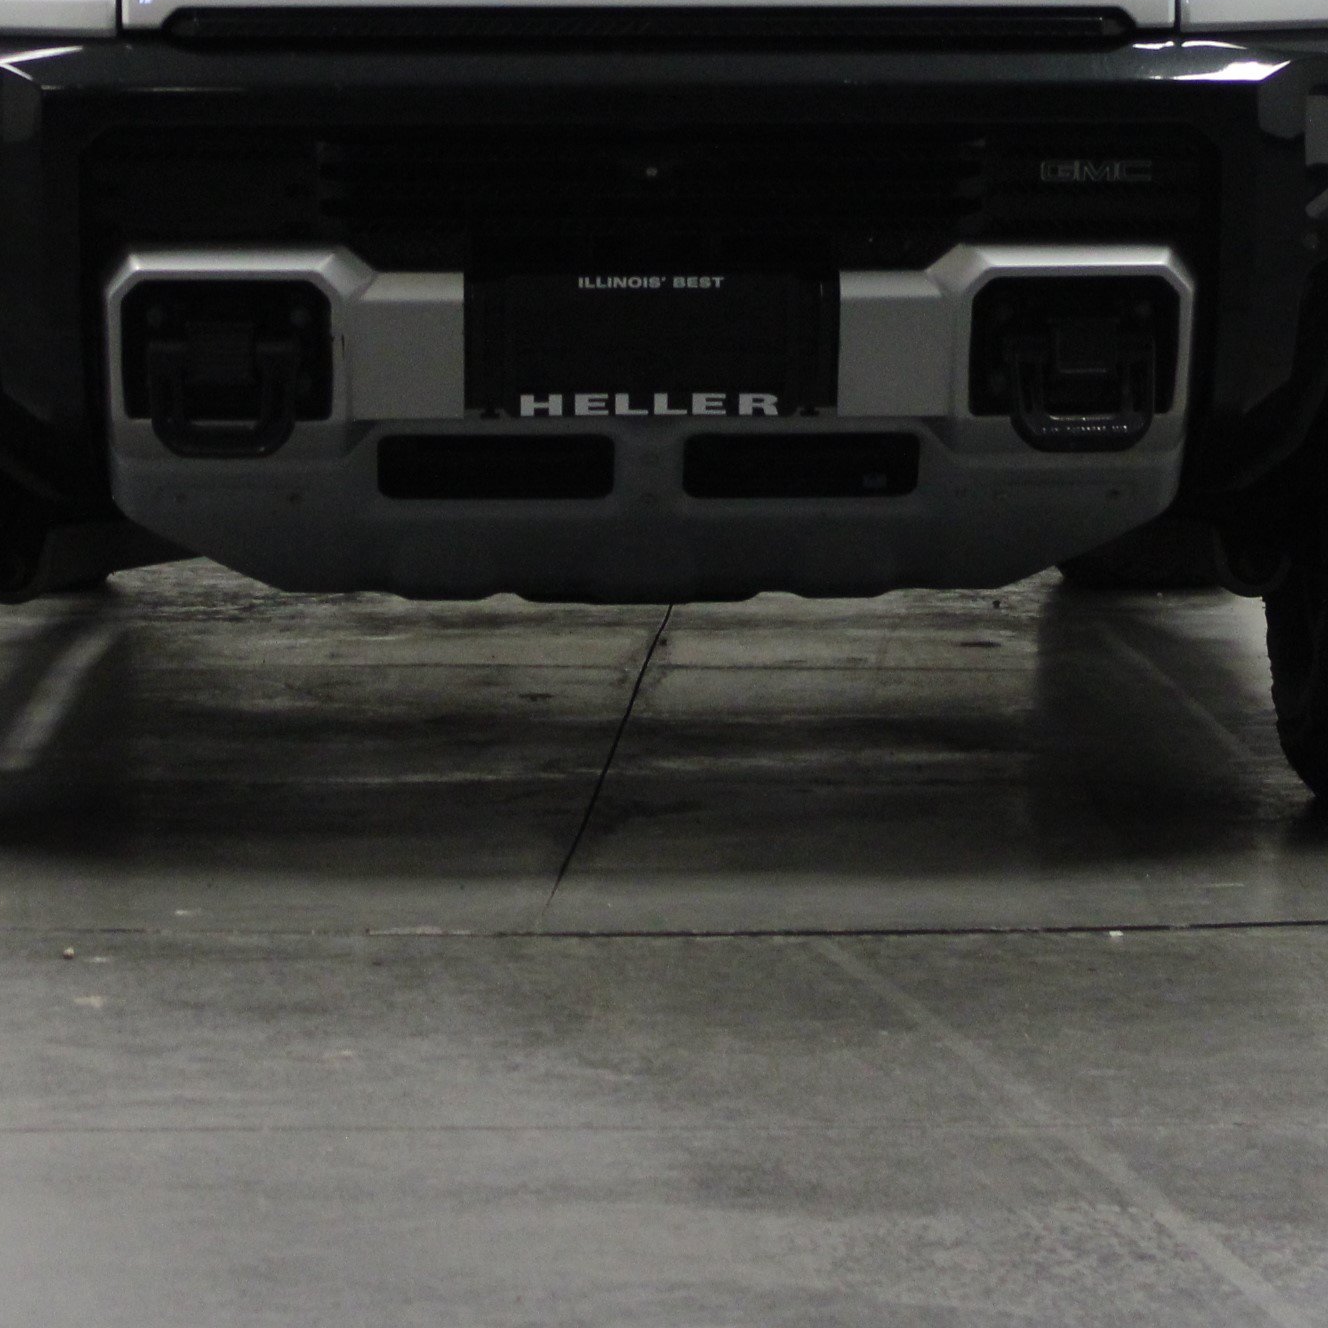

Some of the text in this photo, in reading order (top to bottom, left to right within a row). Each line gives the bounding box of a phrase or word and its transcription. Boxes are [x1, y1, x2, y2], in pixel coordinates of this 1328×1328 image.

[1040, 159, 1152, 182] GMC
[578, 276, 725, 289] ILLINOIS' BEST
[519, 392, 779, 416] HELLER
